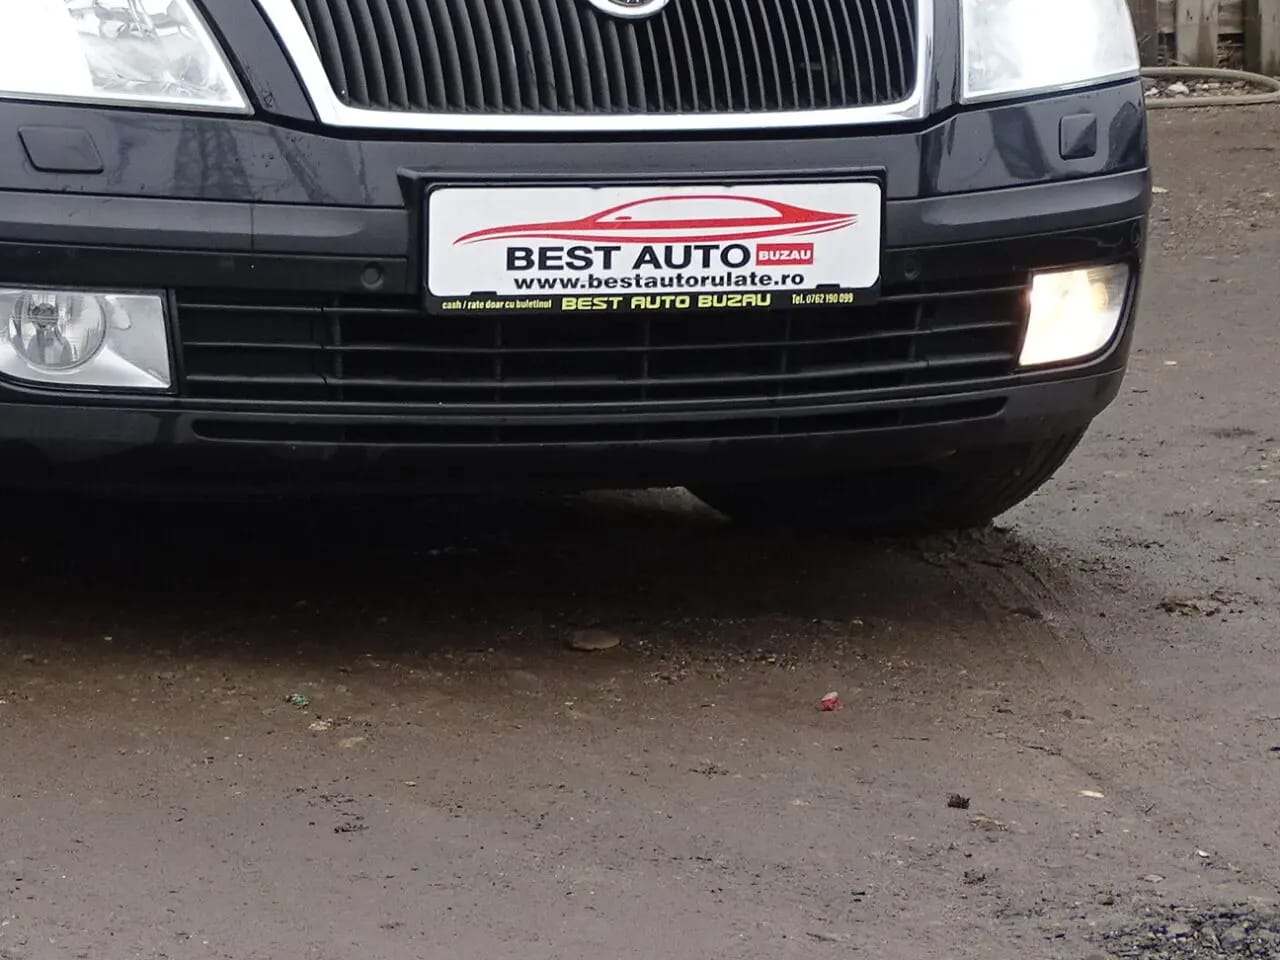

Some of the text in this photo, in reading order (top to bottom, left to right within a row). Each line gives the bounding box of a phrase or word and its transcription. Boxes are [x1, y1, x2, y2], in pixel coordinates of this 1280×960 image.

[506, 243, 813, 271] BEST AUTO BUZAU
[514, 271, 805, 290] www.bestautorulate.ro
[442, 300, 462, 310] cash
[468, 300, 485, 310] rate
[486, 299, 505, 310] doar
[561, 293, 771, 311] BEST AUTO BUZAU
[792, 294, 806, 305] Tel.
